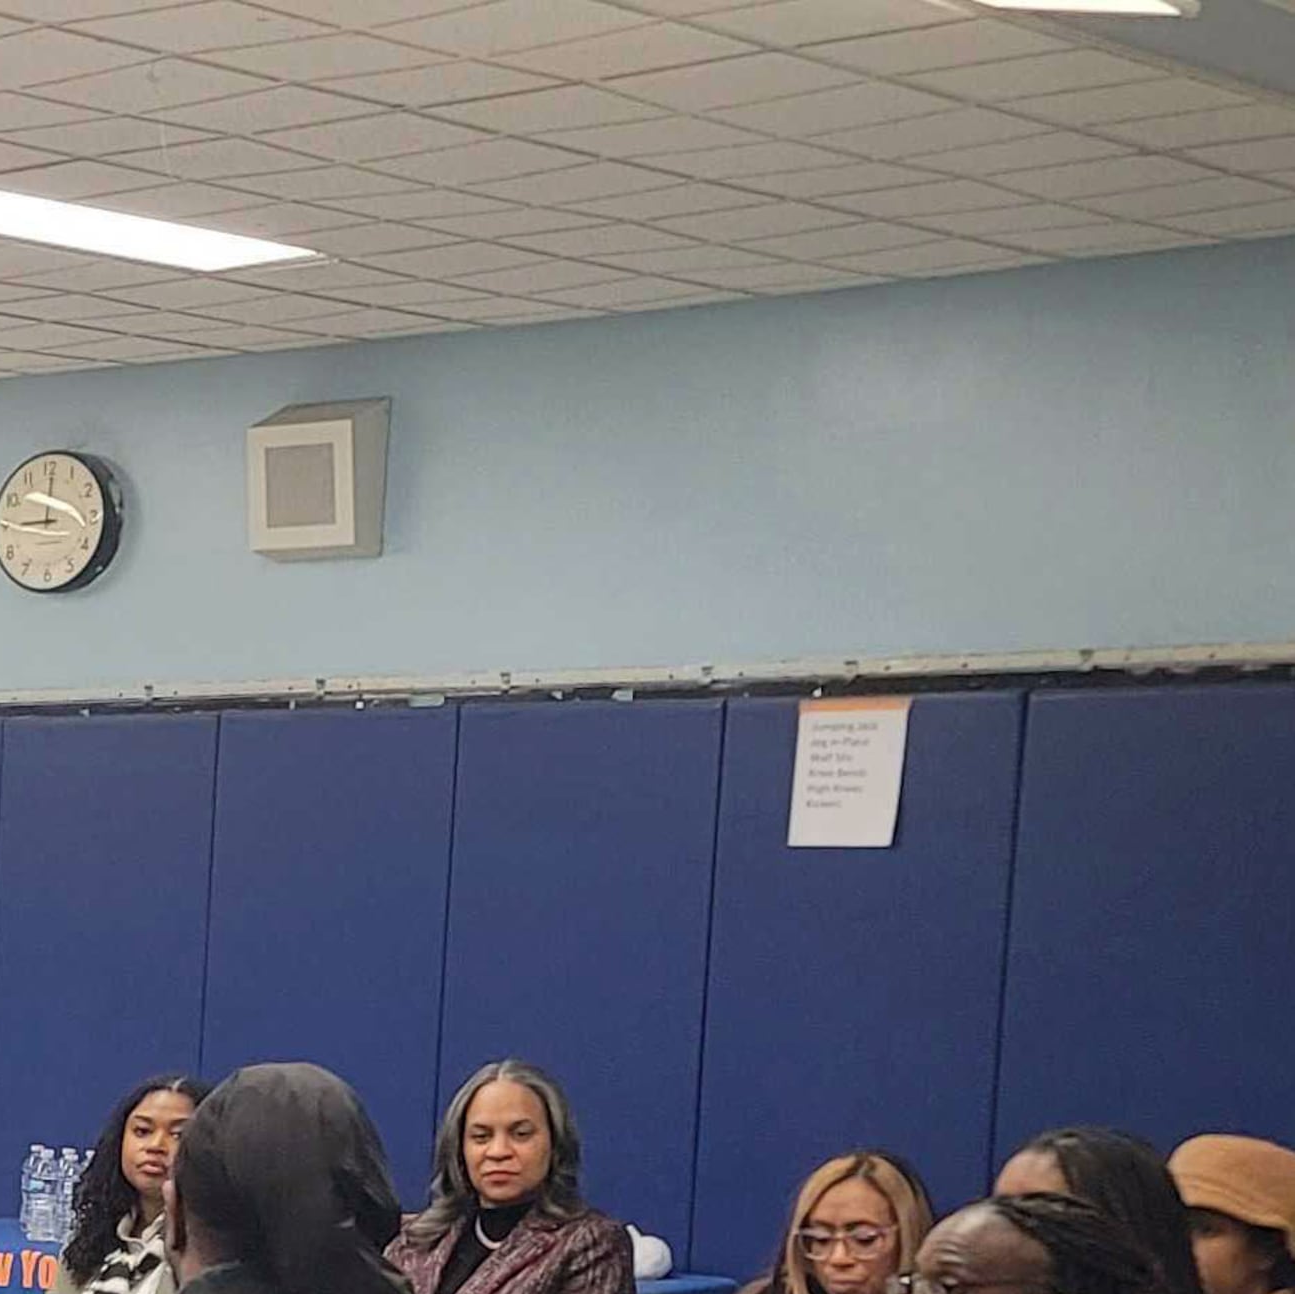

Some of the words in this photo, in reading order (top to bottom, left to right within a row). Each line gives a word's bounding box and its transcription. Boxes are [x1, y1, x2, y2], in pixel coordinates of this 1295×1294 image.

[43, 461, 57, 476] 12
[69, 466, 75, 480] 1
[24, 471, 34, 488] 11
[84, 484, 93, 499] 2
[6, 493, 20, 508] 10
[80, 537, 89, 551] 4
[6, 545, 15, 560] 8
[21, 561, 31, 577] 7
[66, 558, 76, 573] 5
[44, 568, 52, 582] 6
